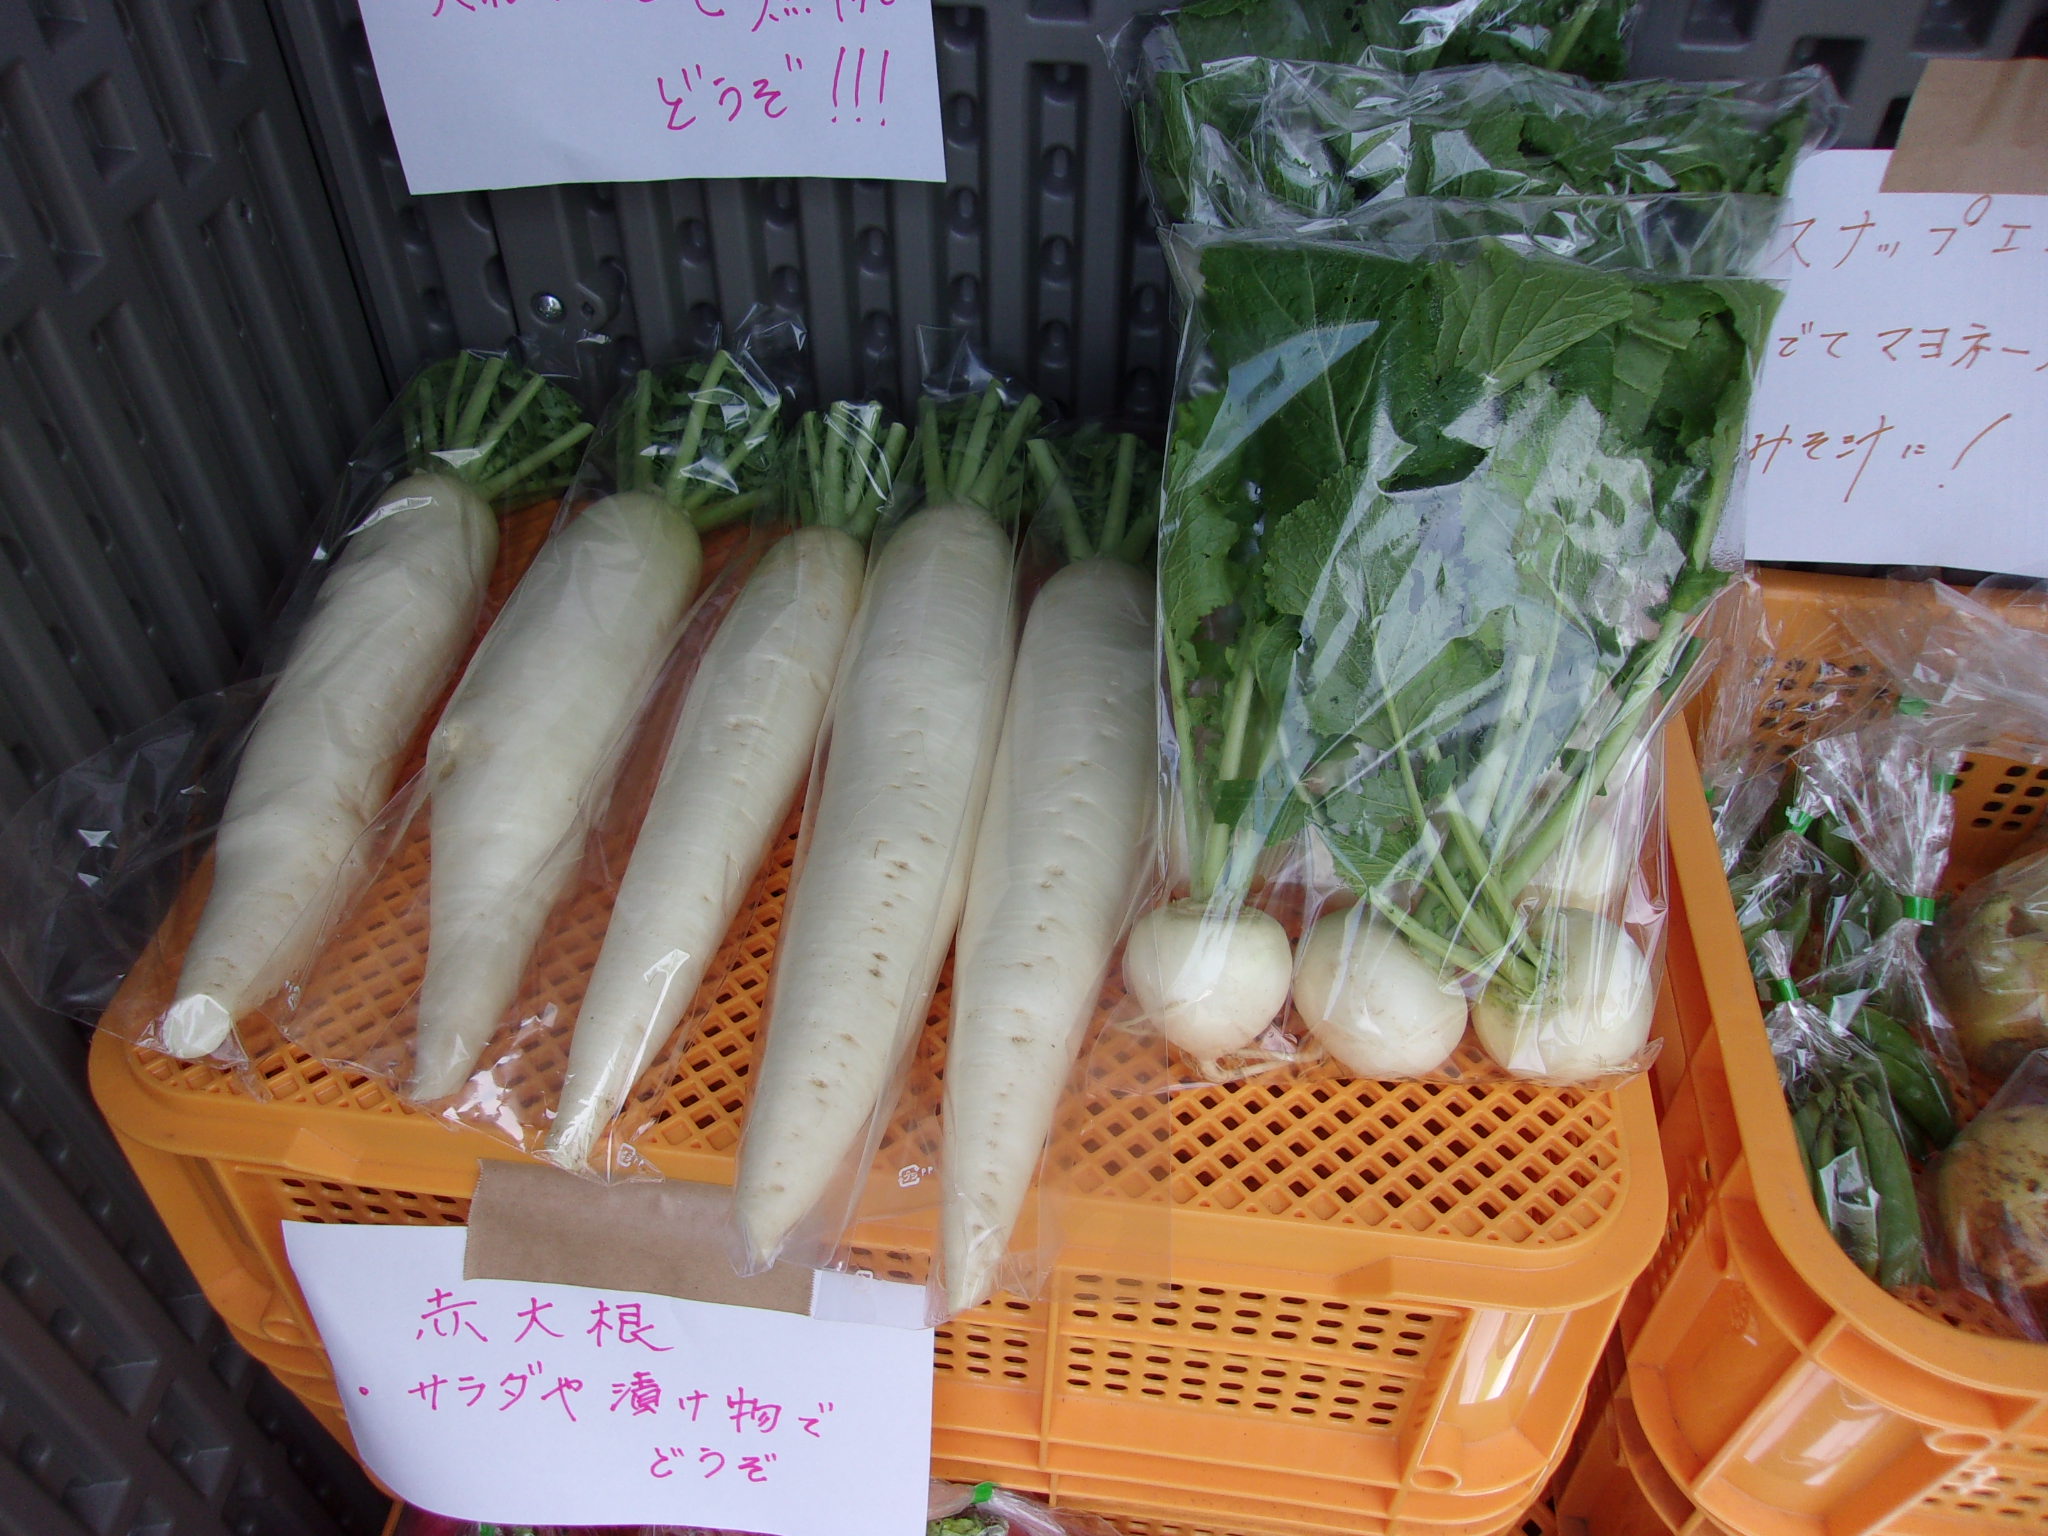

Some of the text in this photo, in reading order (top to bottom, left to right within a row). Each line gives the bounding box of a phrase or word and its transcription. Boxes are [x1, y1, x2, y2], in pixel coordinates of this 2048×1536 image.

[1772, 193, 2048, 270] スナップエ
[415, 1287, 675, 1352] 赤大根
[649, 1446, 778, 1483] どうぞ
